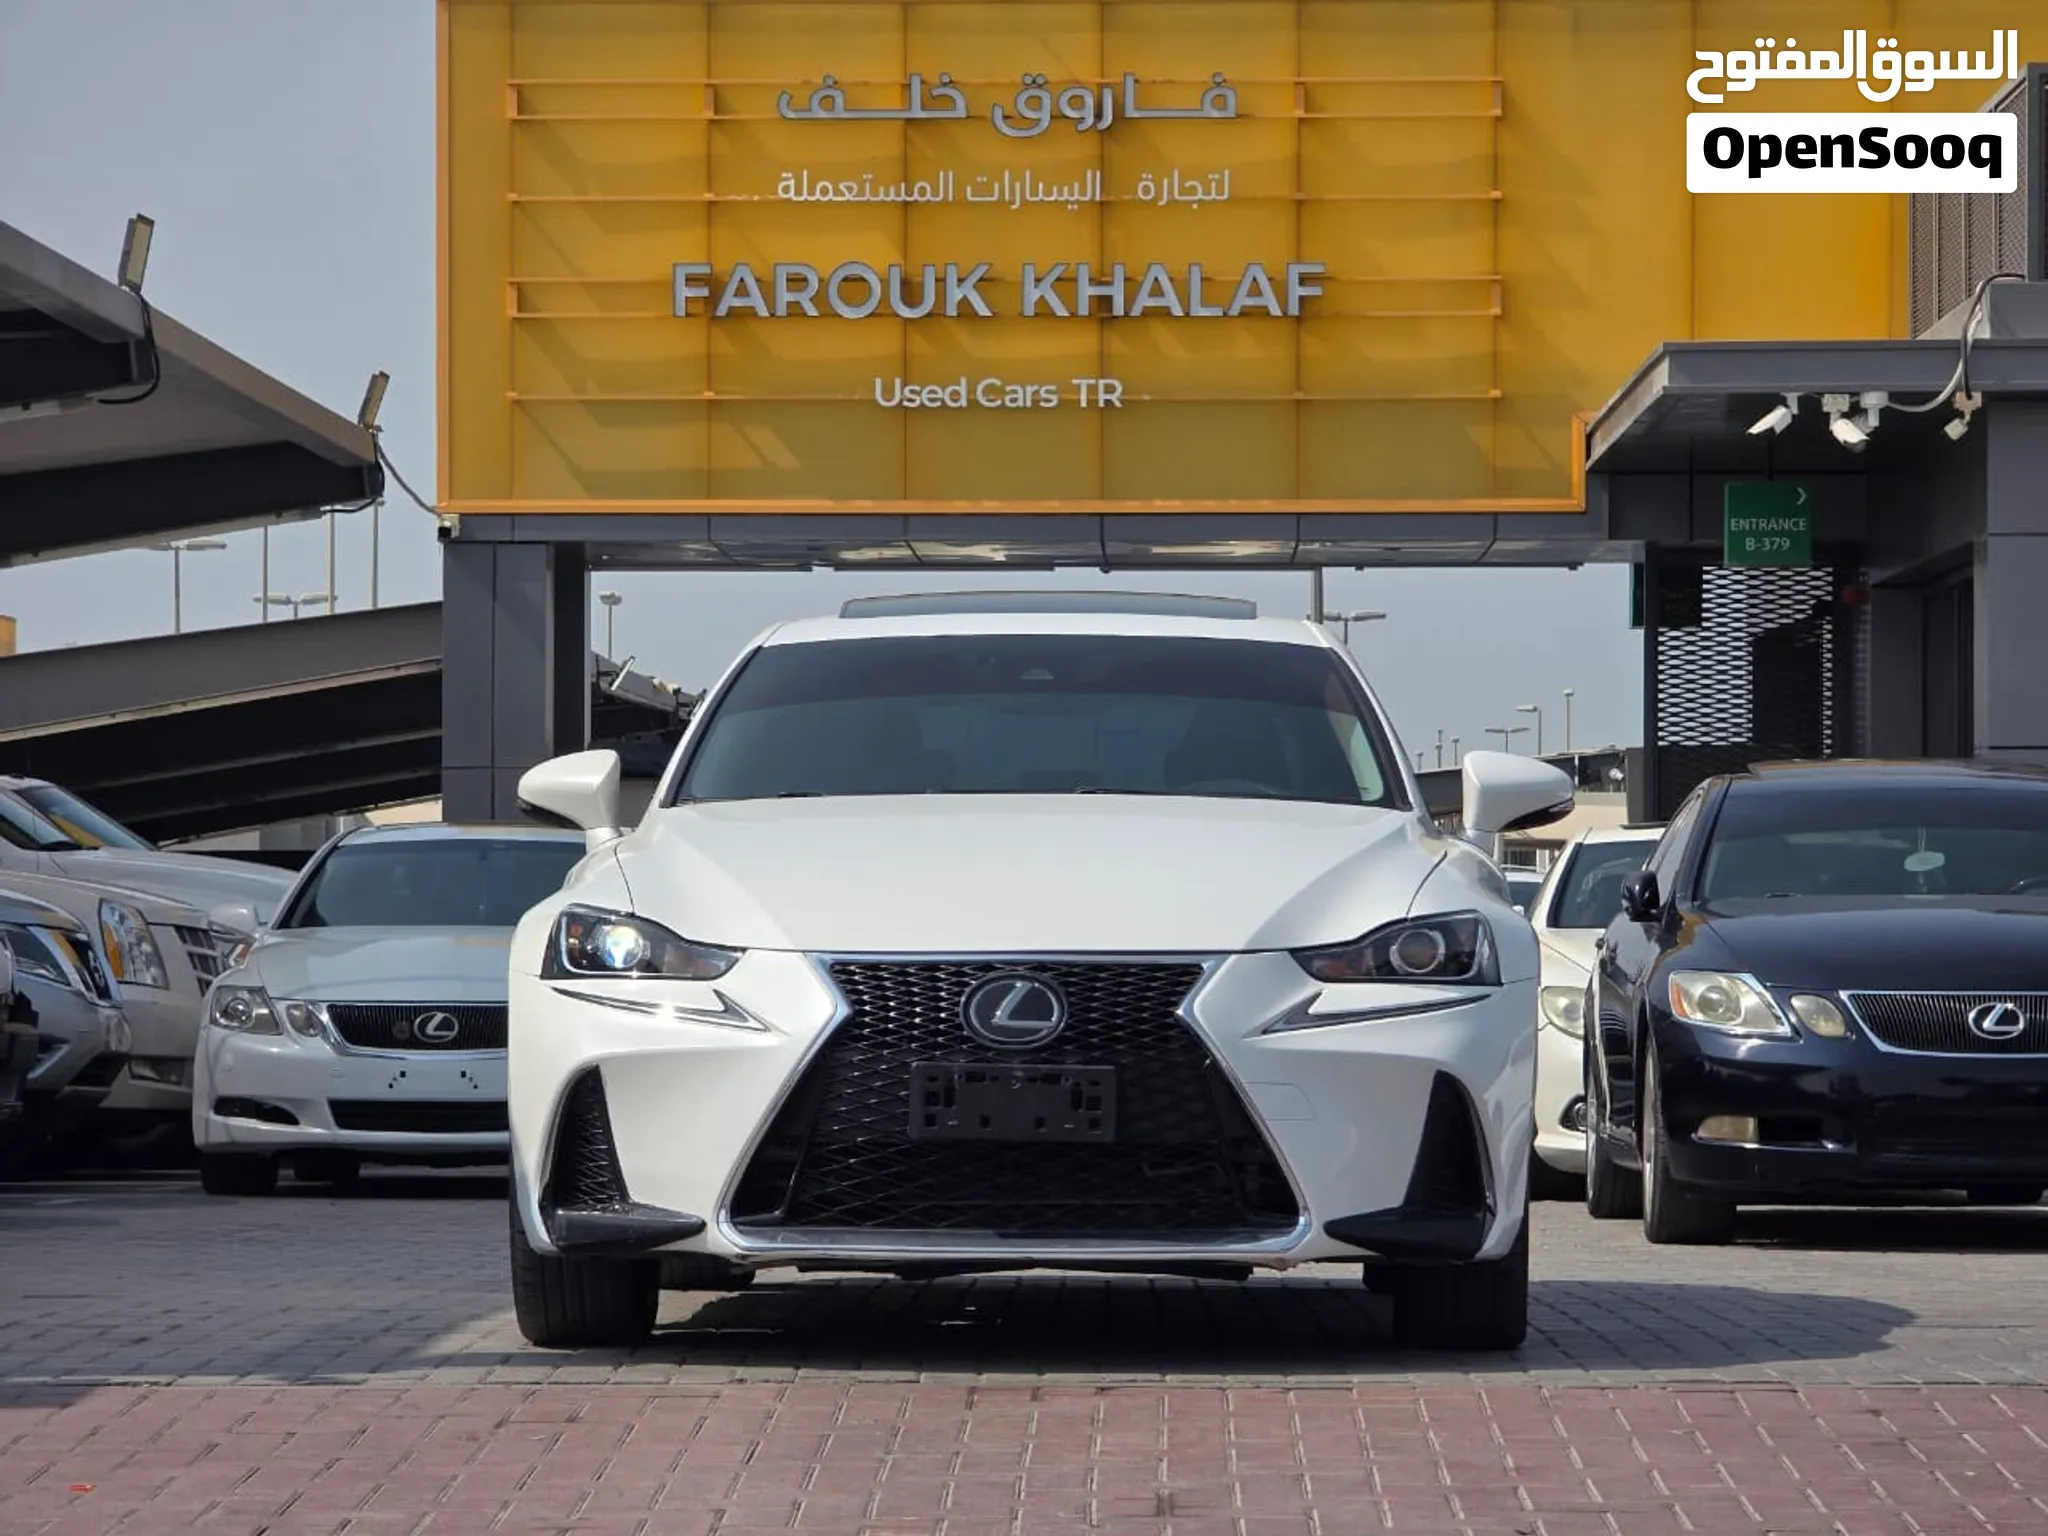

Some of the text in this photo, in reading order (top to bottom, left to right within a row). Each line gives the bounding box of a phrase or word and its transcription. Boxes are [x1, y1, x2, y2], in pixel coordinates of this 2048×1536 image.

[777, 72, 1238, 138] فاروق خلف
[777, 168, 954, 203] المستعملة
[1137, 168, 1231, 209] لتجارة
[671, 261, 1327, 320] FAROUK KHALAF
[873, 377, 1124, 409] Used Cars TR
[1730, 517, 1807, 532] ENTRANCE
[1745, 537, 1791, 551] B-379
